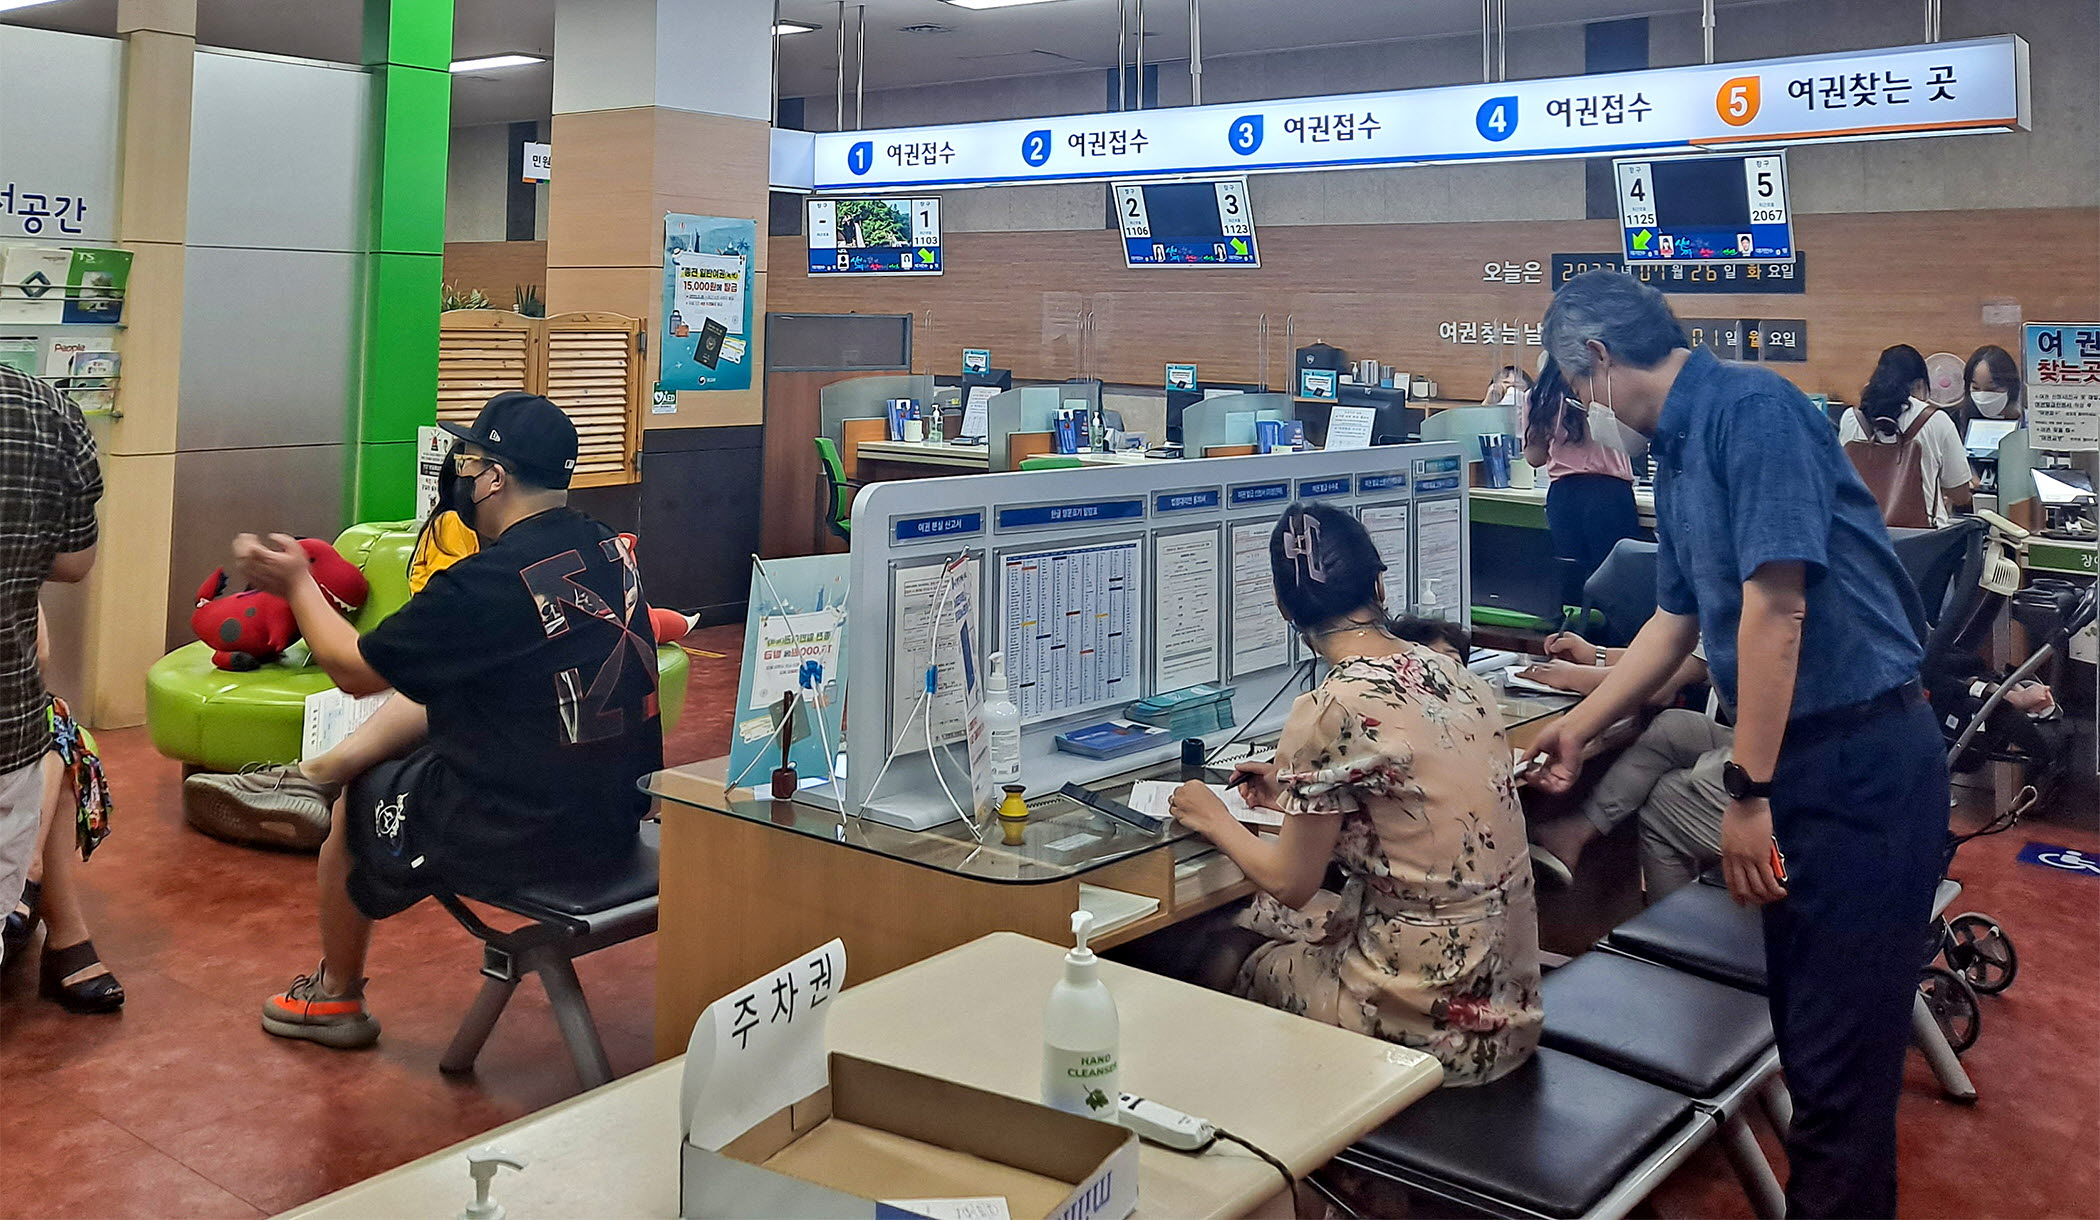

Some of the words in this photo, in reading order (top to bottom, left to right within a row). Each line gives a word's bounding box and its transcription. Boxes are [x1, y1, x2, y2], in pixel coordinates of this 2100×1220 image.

[1729, 86, 1748, 117] 5
[1788, 70, 1912, 111] 여권찾는
[1925, 64, 1957, 102] 곳
[1487, 105, 1507, 133] 4
[1546, 92, 1653, 128] 여권접수
[1238, 122, 1254, 148] 3
[1284, 112, 1382, 143] 여권접수
[1030, 136, 1044, 160] 2
[1068, 129, 1149, 157] 여권접수
[855, 148, 864, 169] 1
[886, 141, 956, 166] 여권접수
[1630, 178, 1646, 202] 4
[1757, 172, 1773, 197] 5
[1126, 198, 1140, 217] 2
[1224, 194, 1239, 215] 3
[920, 210, 929, 228] 1
[1627, 214, 1655, 225] 1125
[1752, 210, 1783, 222] 2067
[1126, 226, 1149, 236] 1106
[1224, 225, 1249, 234] 1123
[915, 236, 938, 245] 1103
[78, 252, 96, 261] TS
[1482, 260, 1543, 284] 오늘은
[1671, 264, 1683, 280] 월
[1724, 264, 1736, 279] 일
[1767, 264, 1794, 279] 요일
[1769, 331, 1796, 347] 요일
[945, 518, 962, 530] 신고서
[1081, 1054, 1111, 1065] HAND
